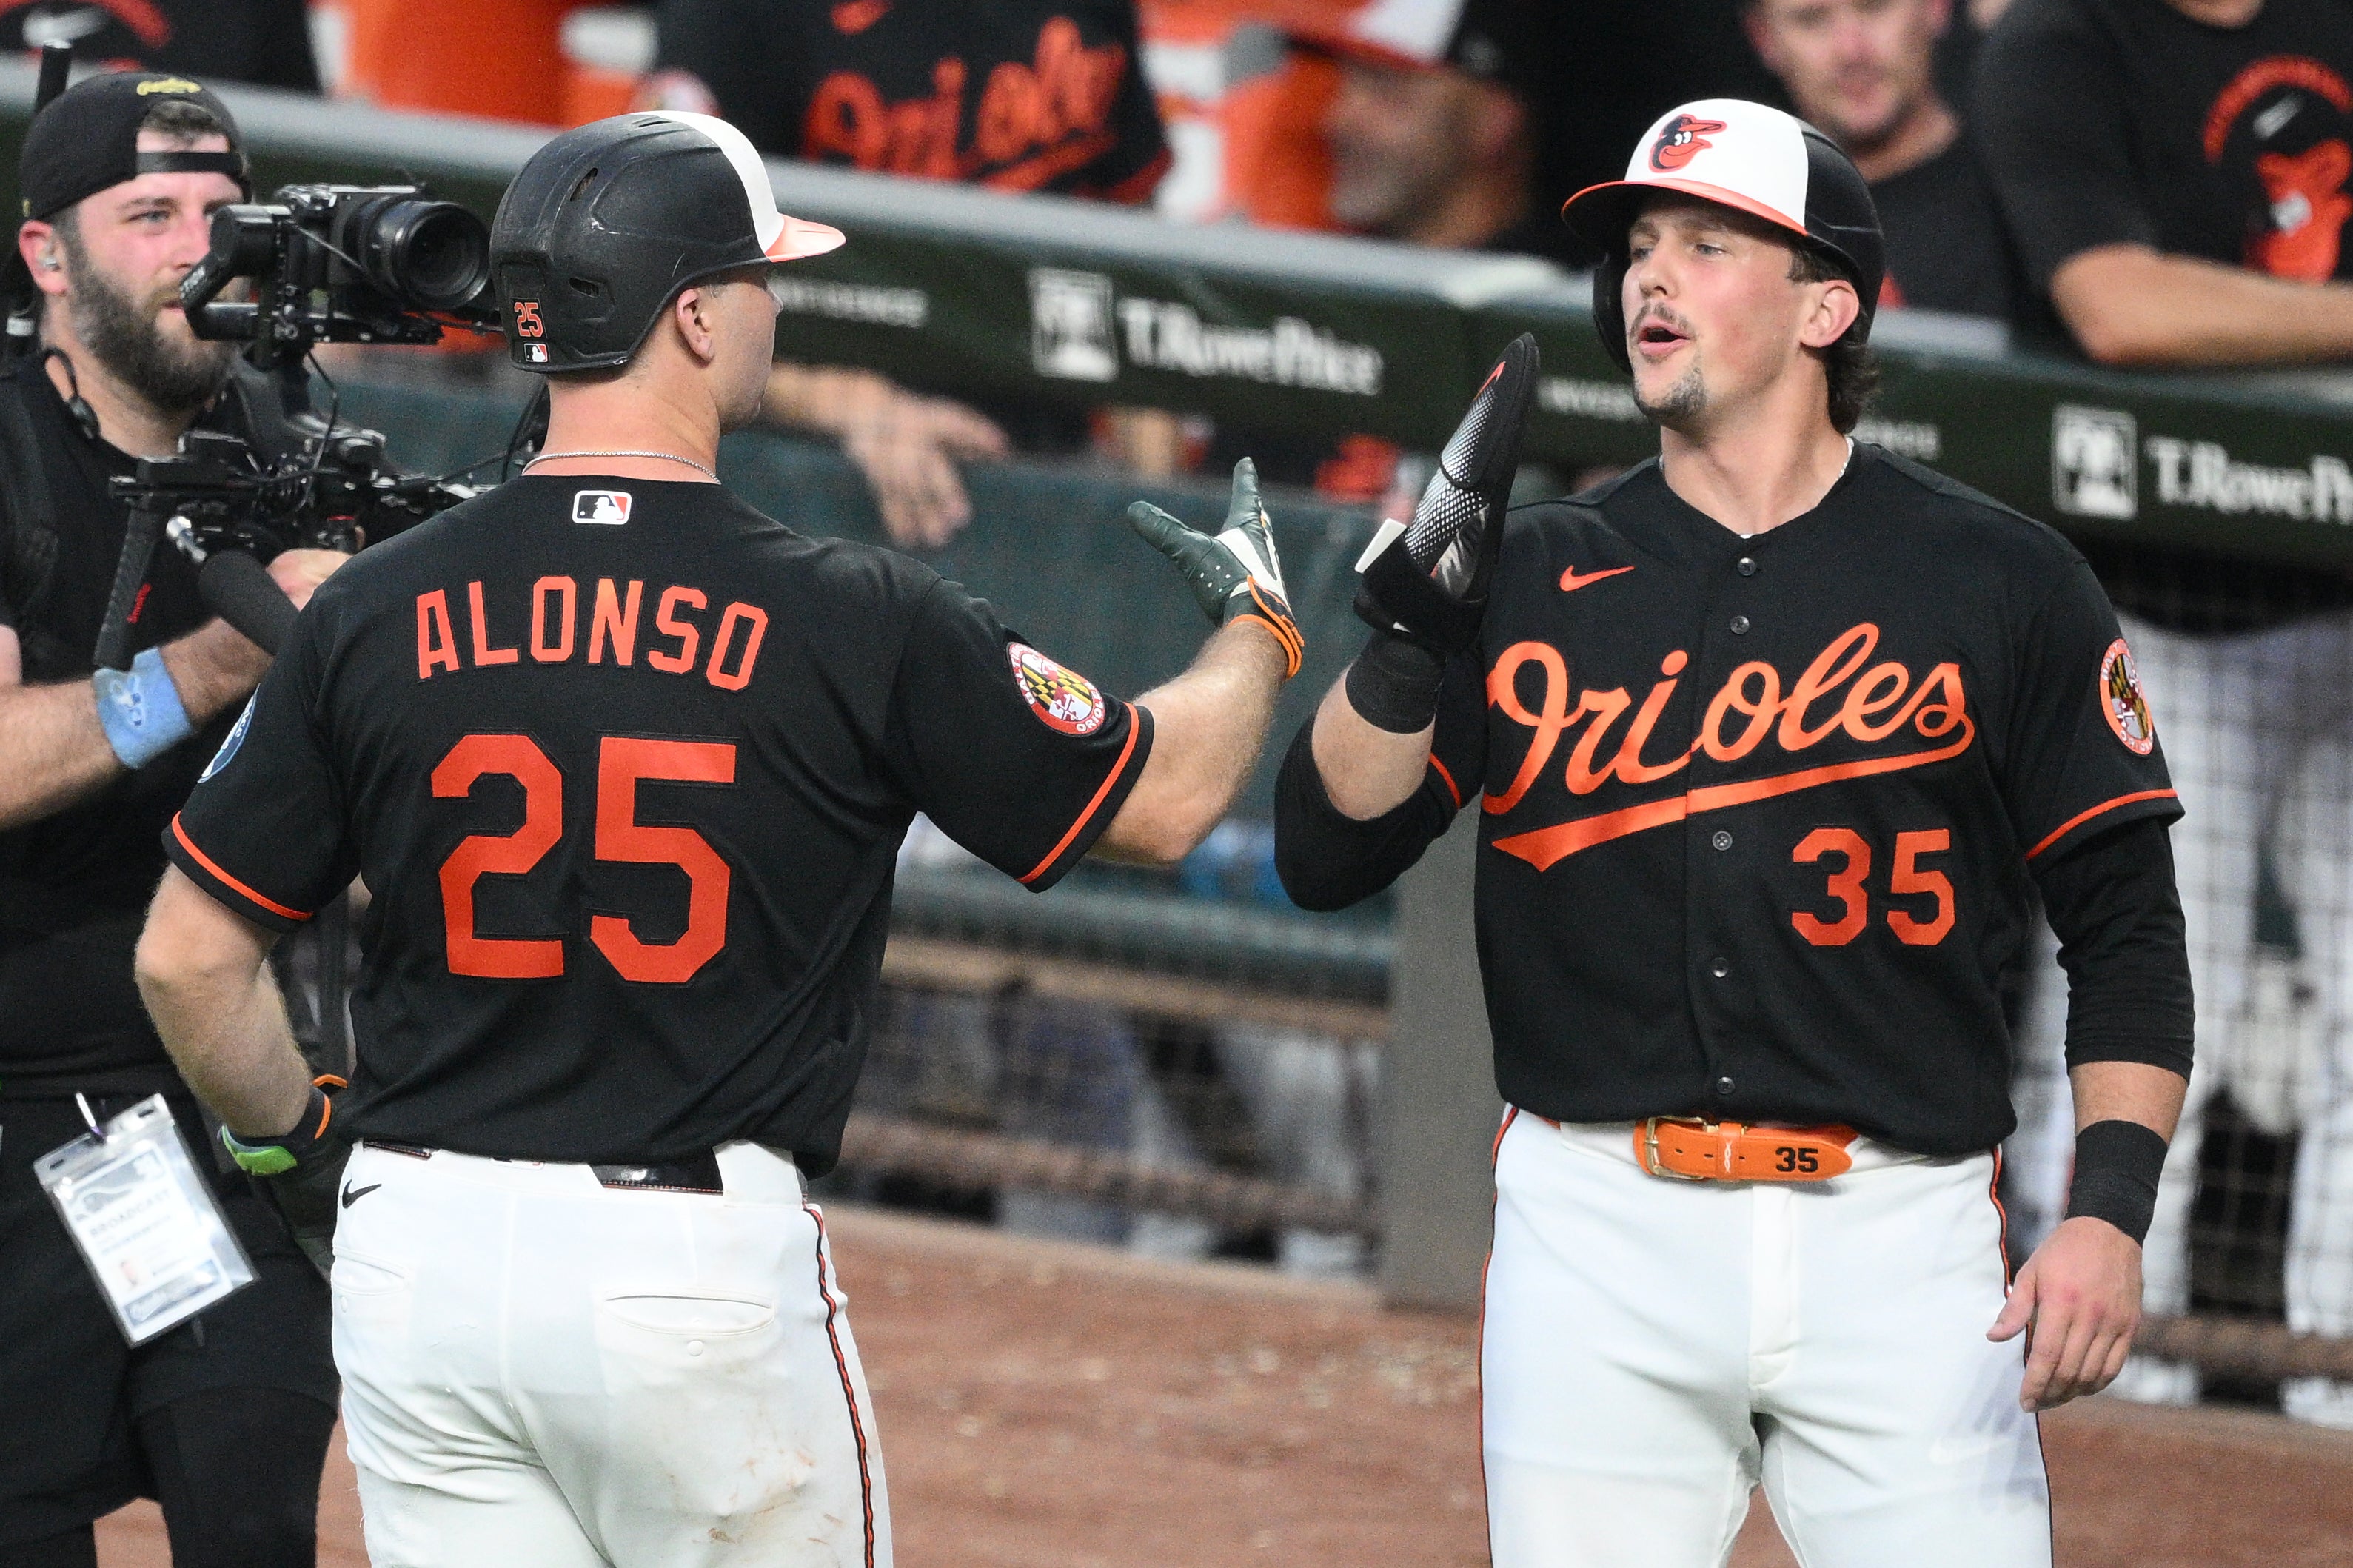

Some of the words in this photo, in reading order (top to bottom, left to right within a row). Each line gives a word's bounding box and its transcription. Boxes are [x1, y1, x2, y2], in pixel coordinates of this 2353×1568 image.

[515, 302, 543, 338] 25
[416, 575, 769, 691] ALONSO
[1483, 622, 1975, 816] Orioles
[432, 734, 737, 983] 25
[1791, 828, 1956, 946] 35
[1775, 1147, 1818, 1173] 35
